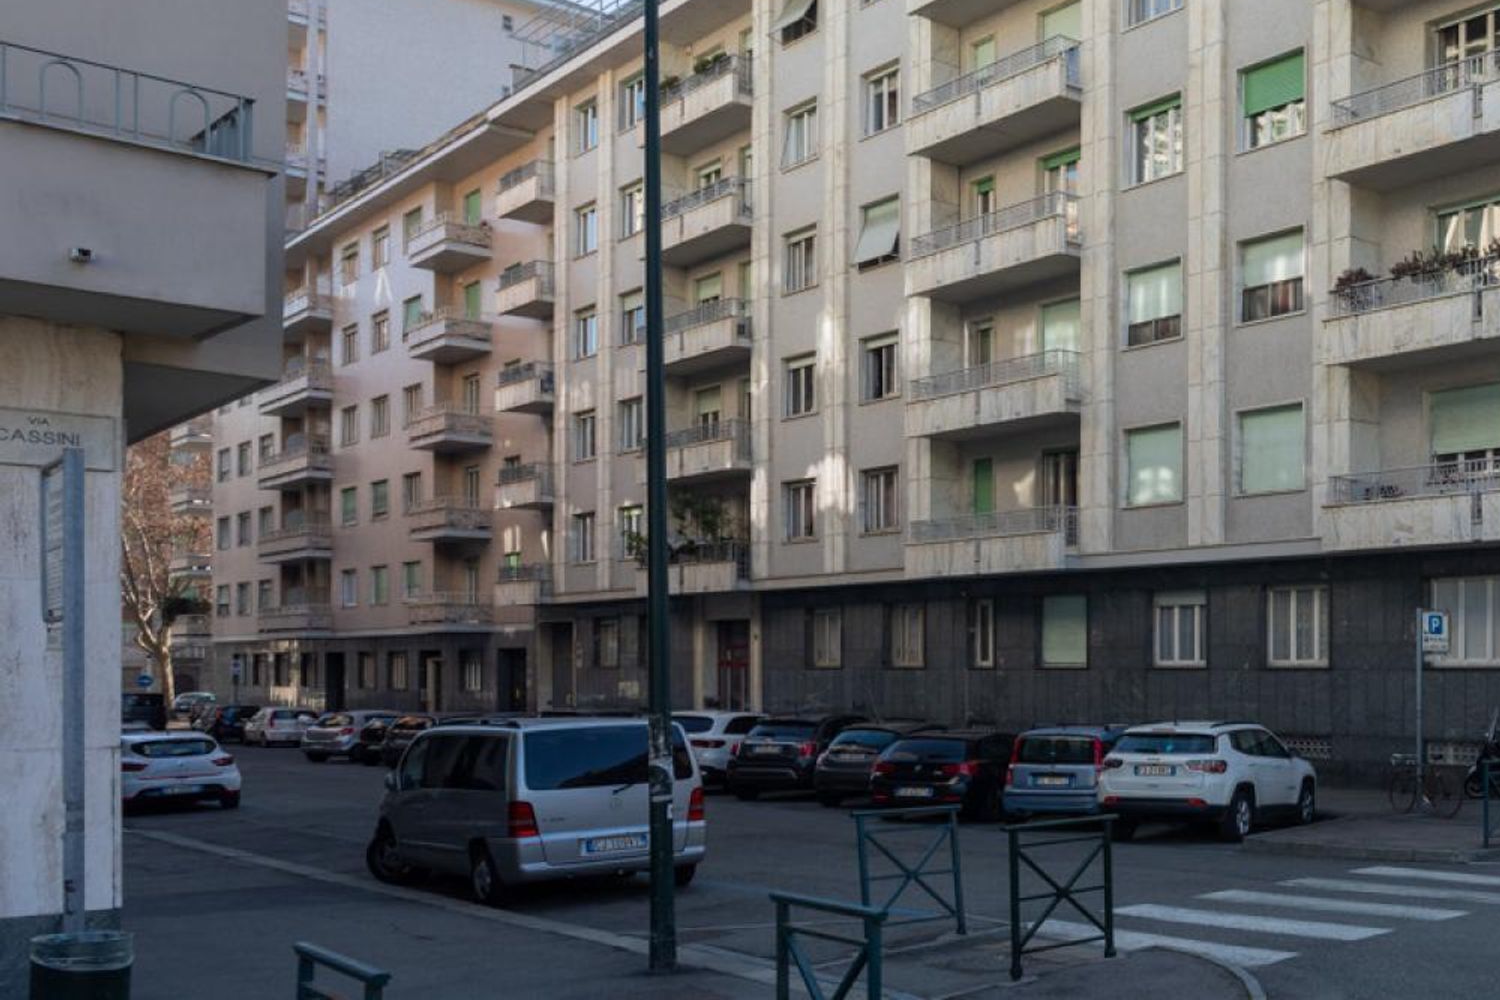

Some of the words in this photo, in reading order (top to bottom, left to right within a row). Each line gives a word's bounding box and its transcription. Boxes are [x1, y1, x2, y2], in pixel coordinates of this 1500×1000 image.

[27, 415, 50, 426] VIA
[0, 428, 80, 447] CASSINI
[1431, 617, 1441, 633] P
